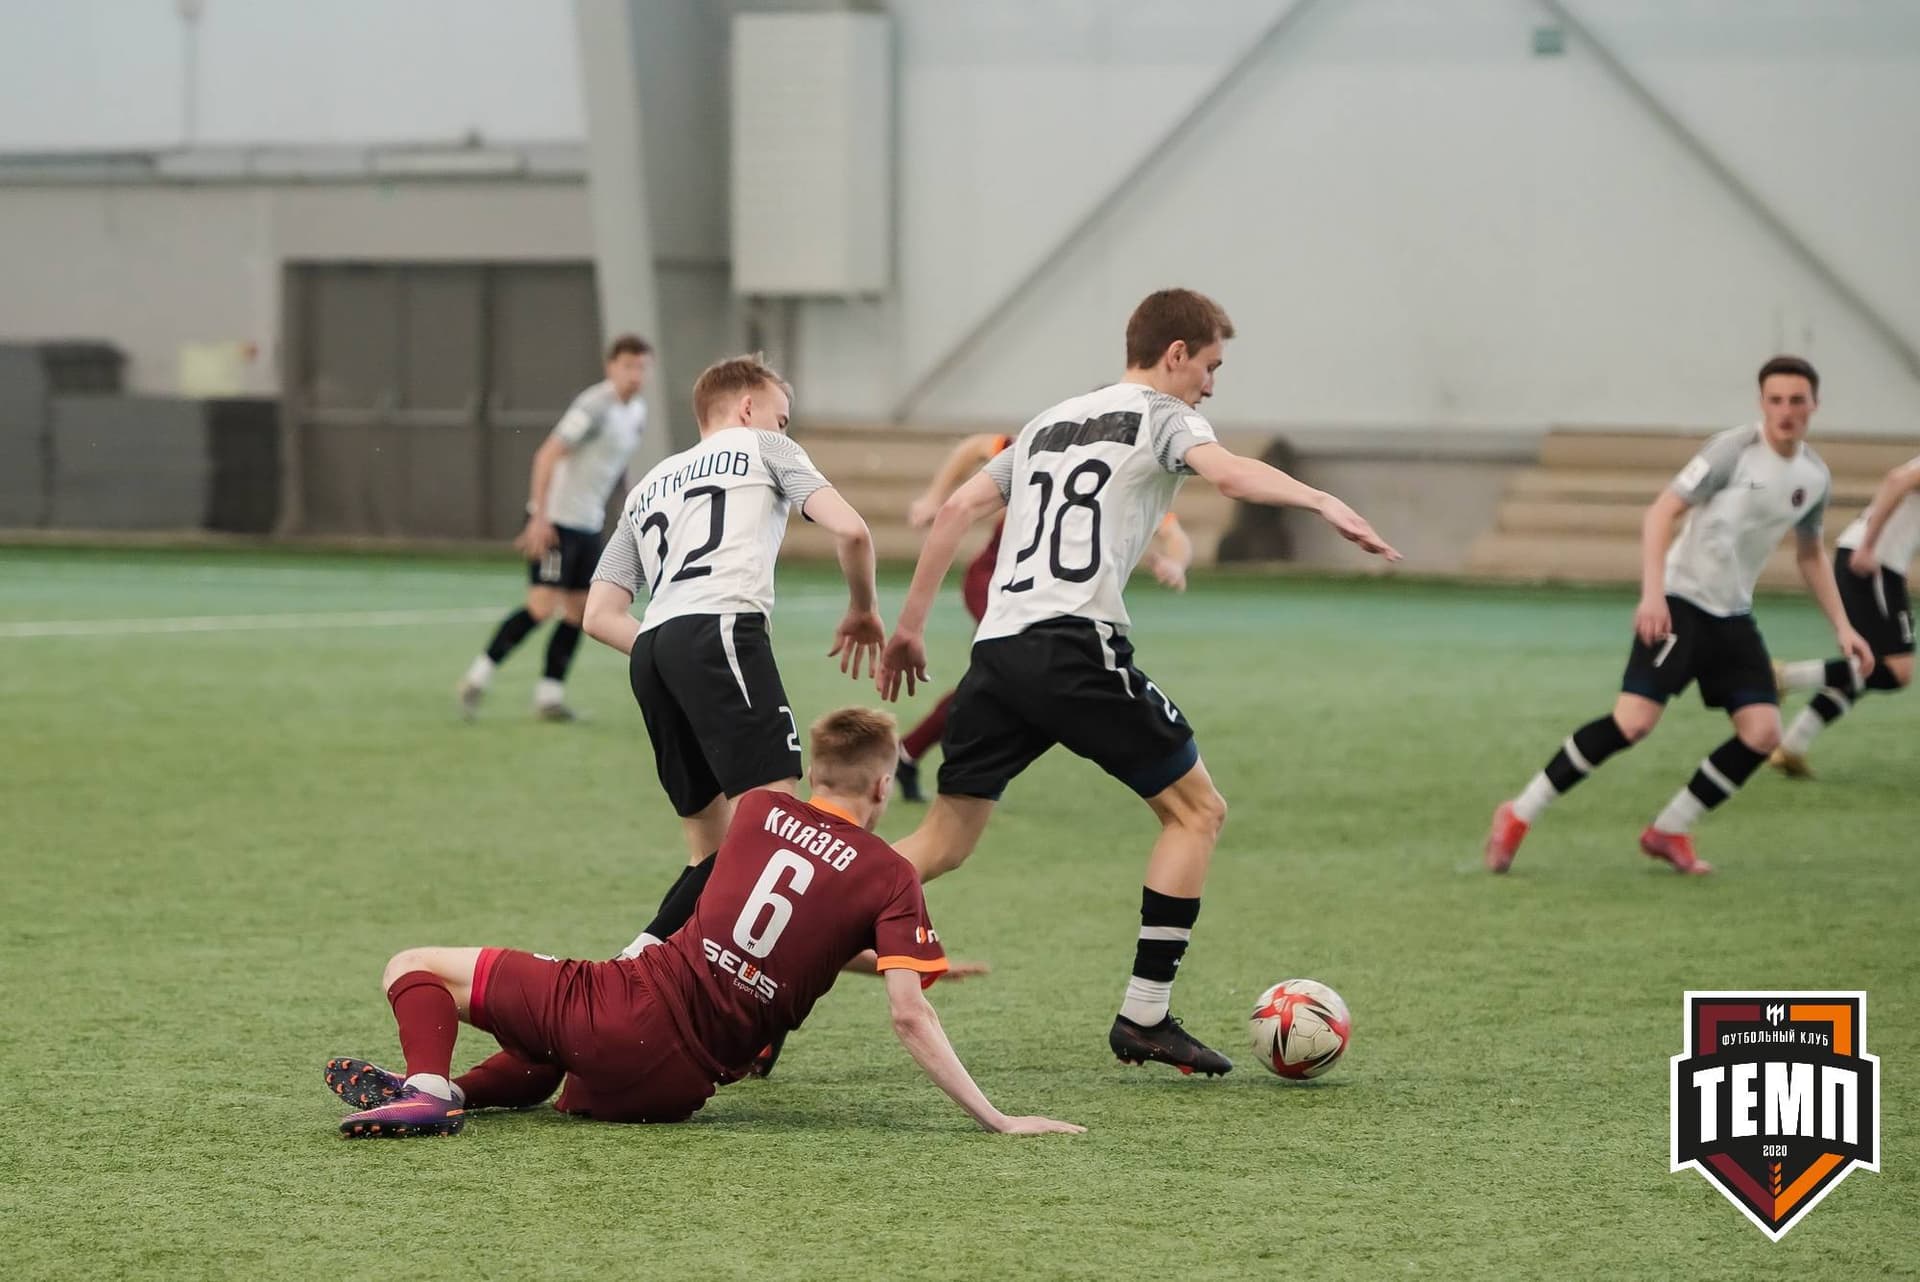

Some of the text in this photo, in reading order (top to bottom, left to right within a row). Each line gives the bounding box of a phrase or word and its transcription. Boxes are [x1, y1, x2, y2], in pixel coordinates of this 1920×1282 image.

[1001, 459, 1111, 583] 28
[732, 849, 815, 958] 6
[702, 938, 778, 999] SEUS
